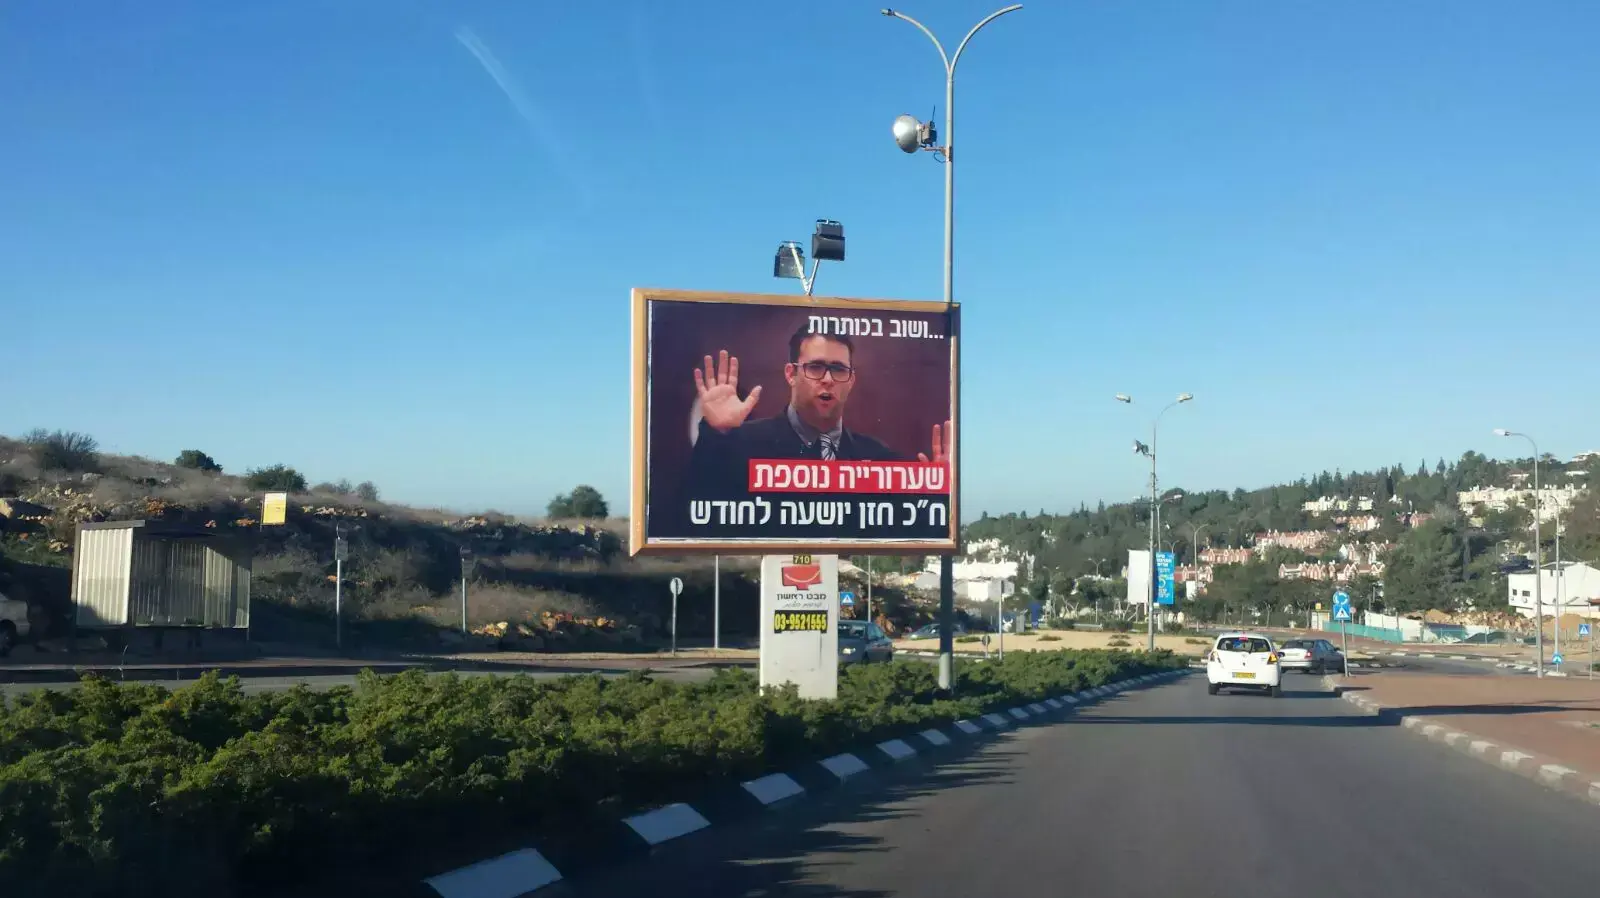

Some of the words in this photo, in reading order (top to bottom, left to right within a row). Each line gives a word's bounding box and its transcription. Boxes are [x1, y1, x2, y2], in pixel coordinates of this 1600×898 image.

[808, 315, 884, 337] בכותרות
[754, 463, 830, 489] נוספת
[839, 464, 944, 490] שערורייה
[690, 496, 772, 525] לחודש
[780, 501, 851, 526] יושעה
[859, 502, 894, 529] חזן
[794, 555, 810, 564] 710
[776, 593, 804, 601] ראשון
[806, 593, 827, 601] מבט
